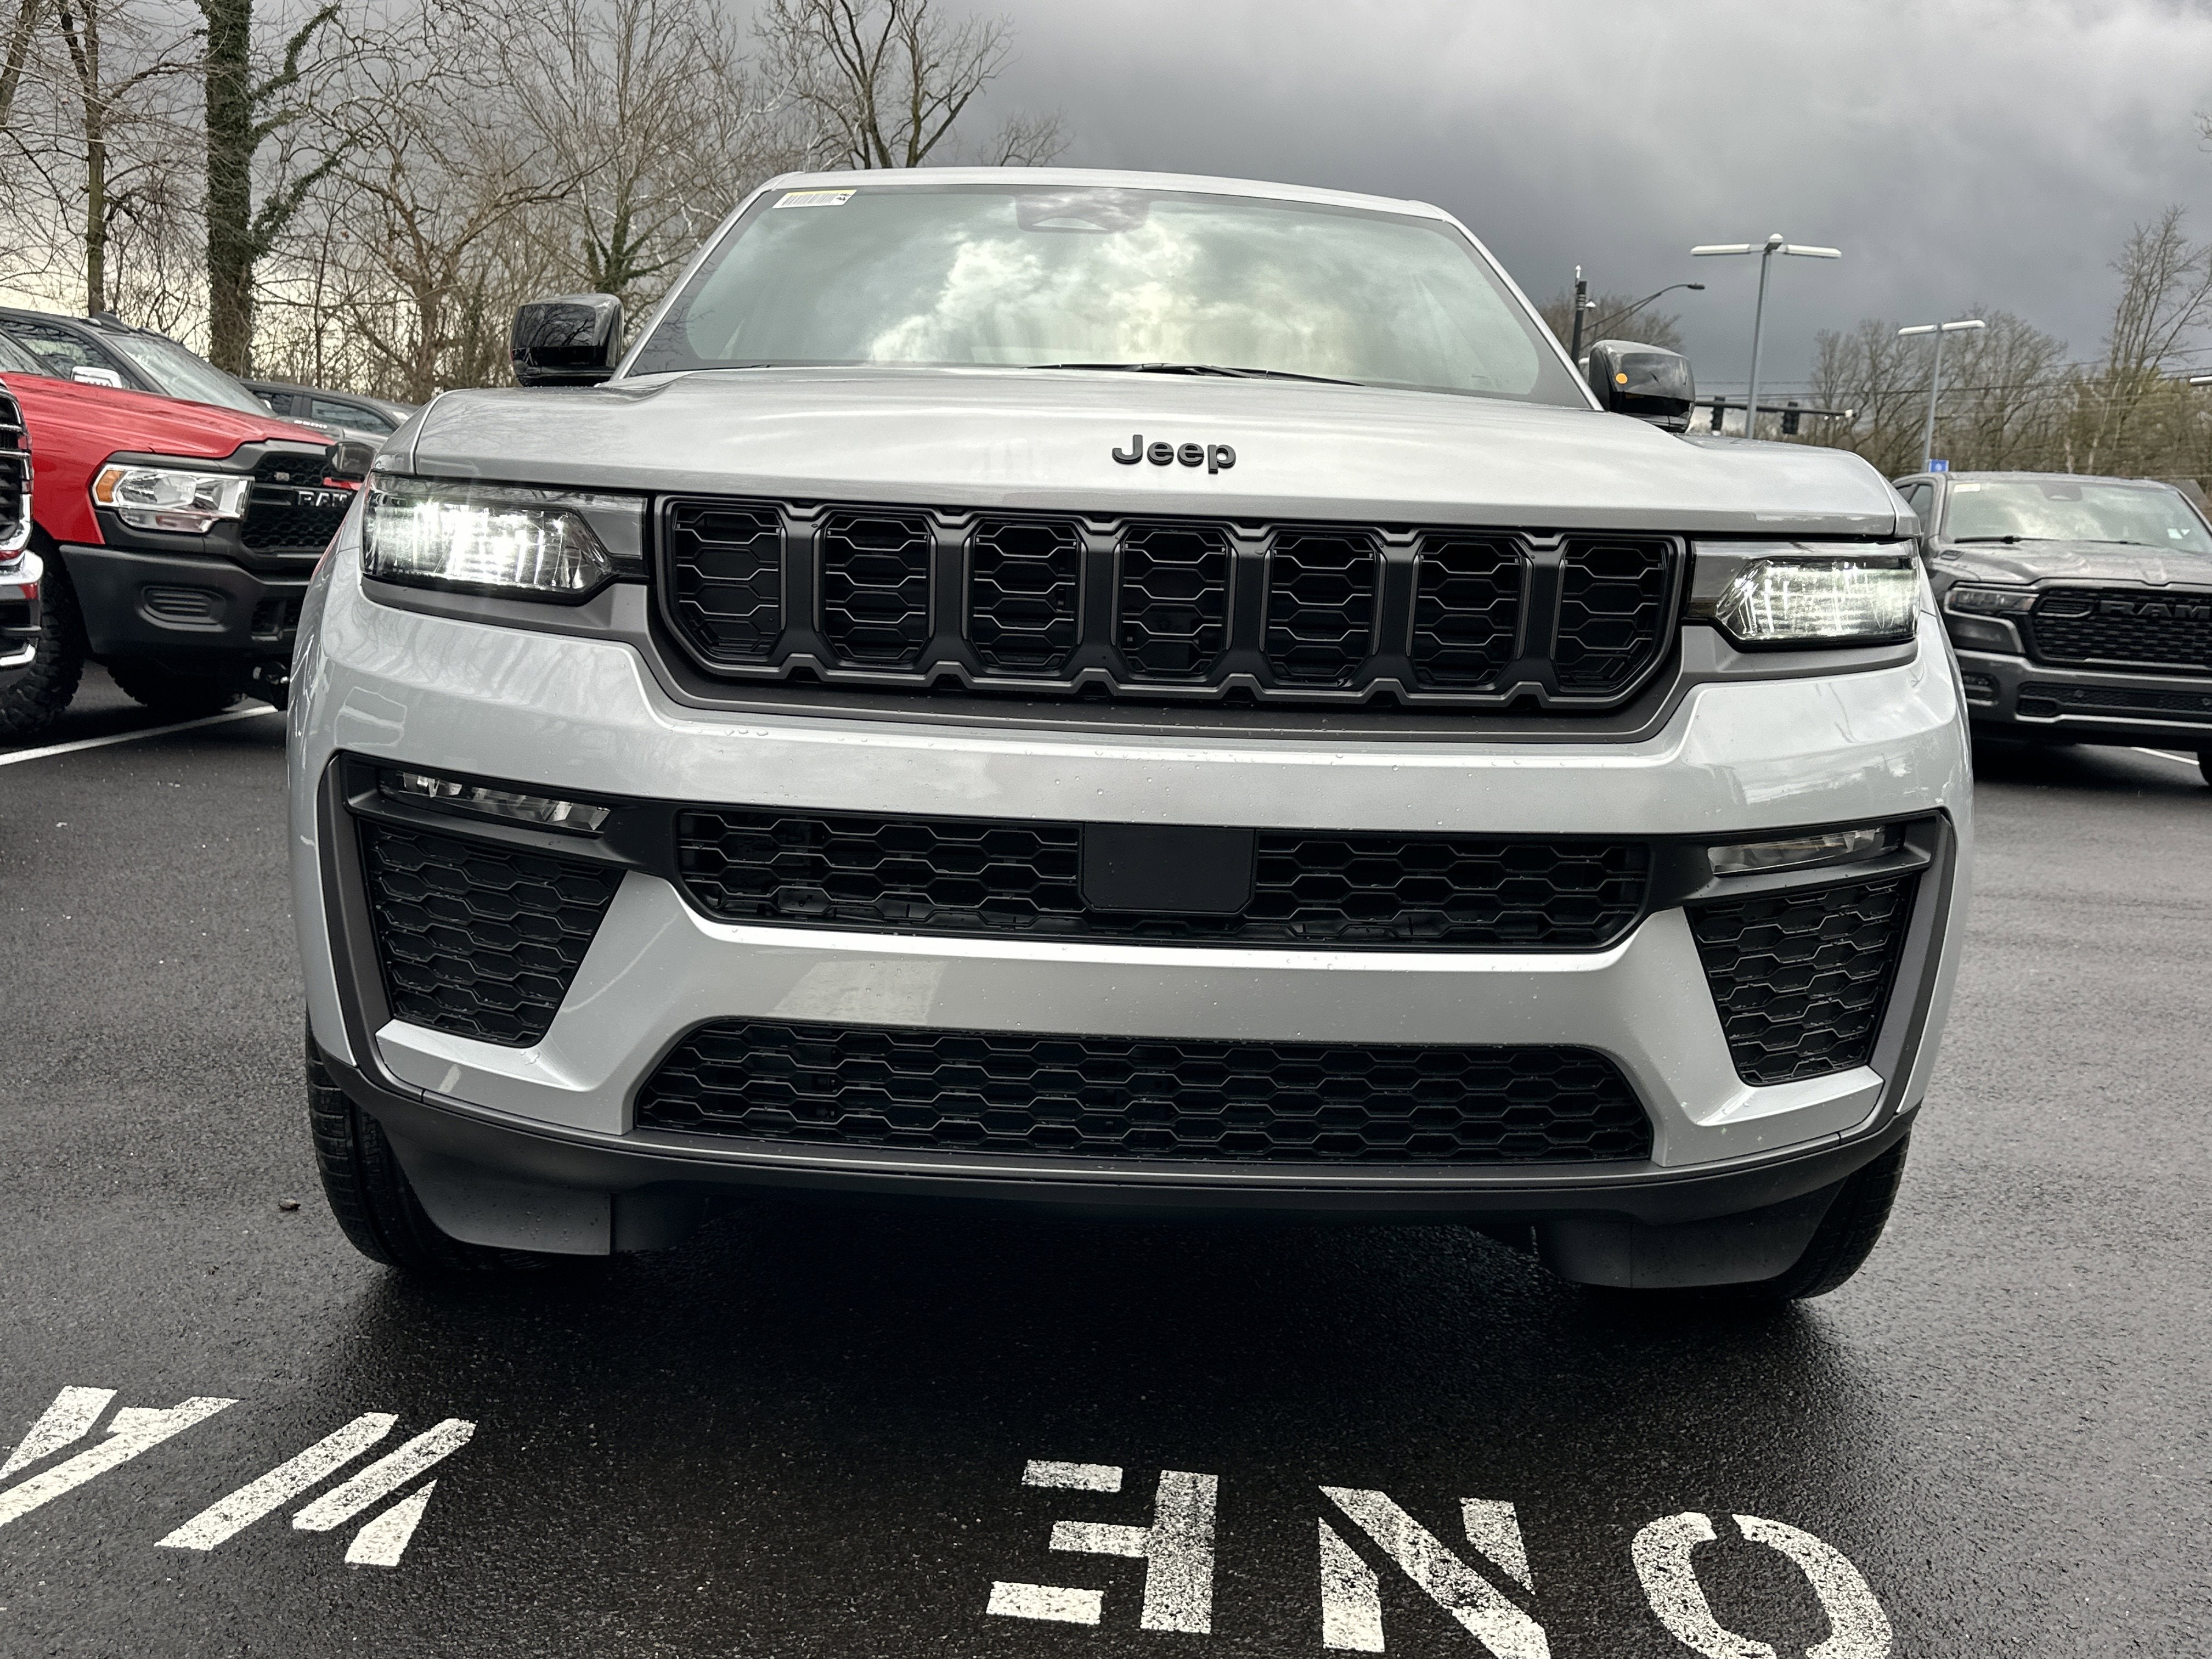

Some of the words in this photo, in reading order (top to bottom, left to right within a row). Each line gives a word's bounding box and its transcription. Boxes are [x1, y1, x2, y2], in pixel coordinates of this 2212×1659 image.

[1112, 435, 1236, 475] Jeep
[298, 490, 348, 508] RAM
[2100, 600, 2210, 619] RAM
[986, 1460, 1894, 1659] ONE
